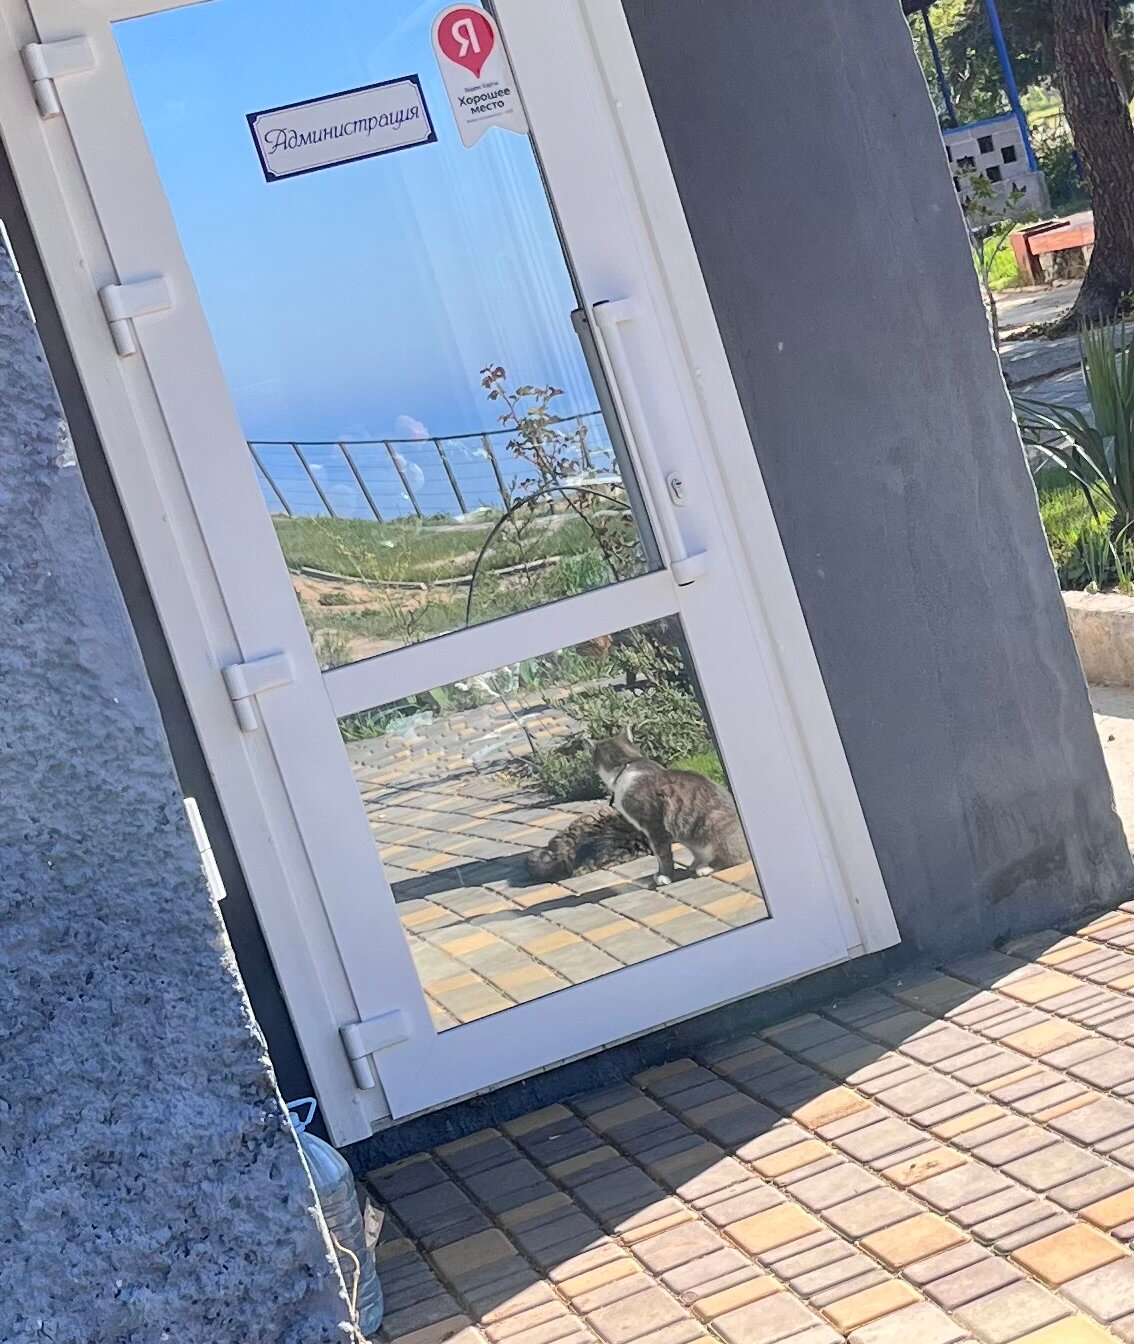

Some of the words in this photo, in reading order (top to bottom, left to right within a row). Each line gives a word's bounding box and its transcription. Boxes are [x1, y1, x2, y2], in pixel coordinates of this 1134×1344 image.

[451, 18, 480, 57] Я
[457, 88, 511, 107] Хорошее
[471, 100, 505, 115] место
[264, 105, 420, 155] Администрация
